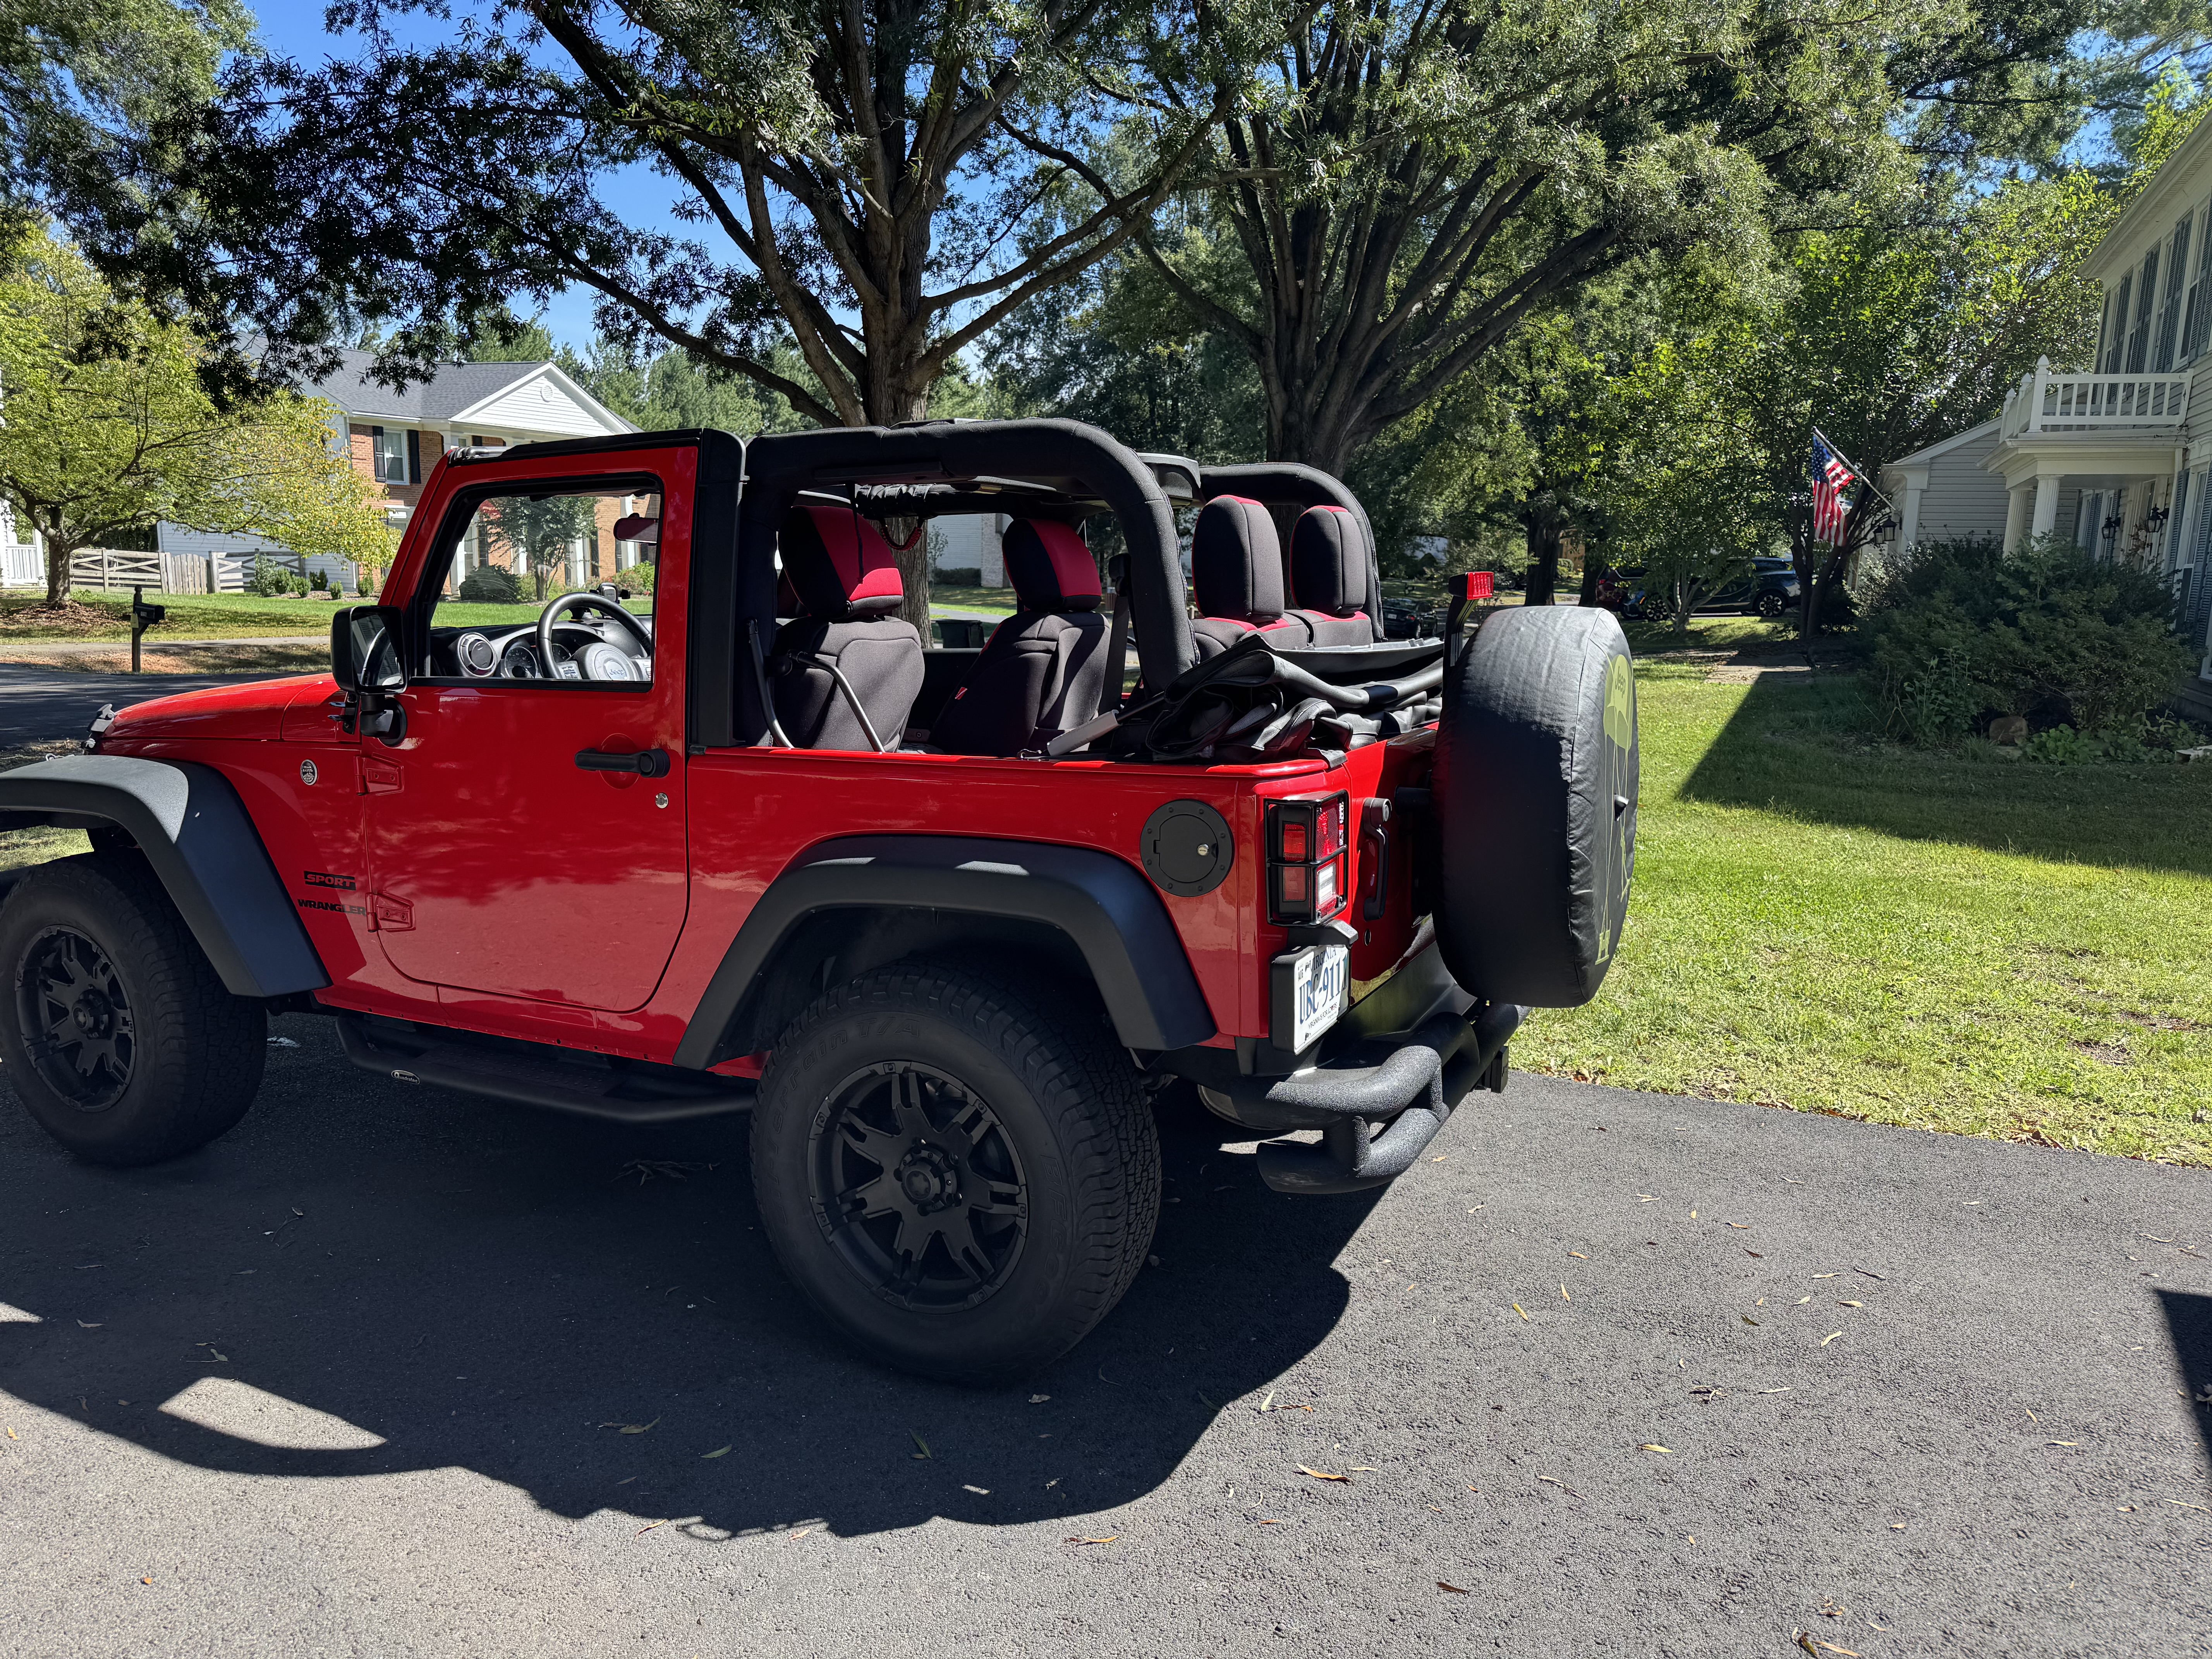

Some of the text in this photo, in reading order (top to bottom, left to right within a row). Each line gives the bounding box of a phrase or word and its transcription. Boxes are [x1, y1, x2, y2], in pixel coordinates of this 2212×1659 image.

[1615, 665, 1626, 699] Jeep
[306, 874, 354, 887] SPORT
[297, 898, 367, 917] WRANGLER
[1309, 947, 1336, 971] VIRGINIA
[856, 1017, 921, 1038] T/A
